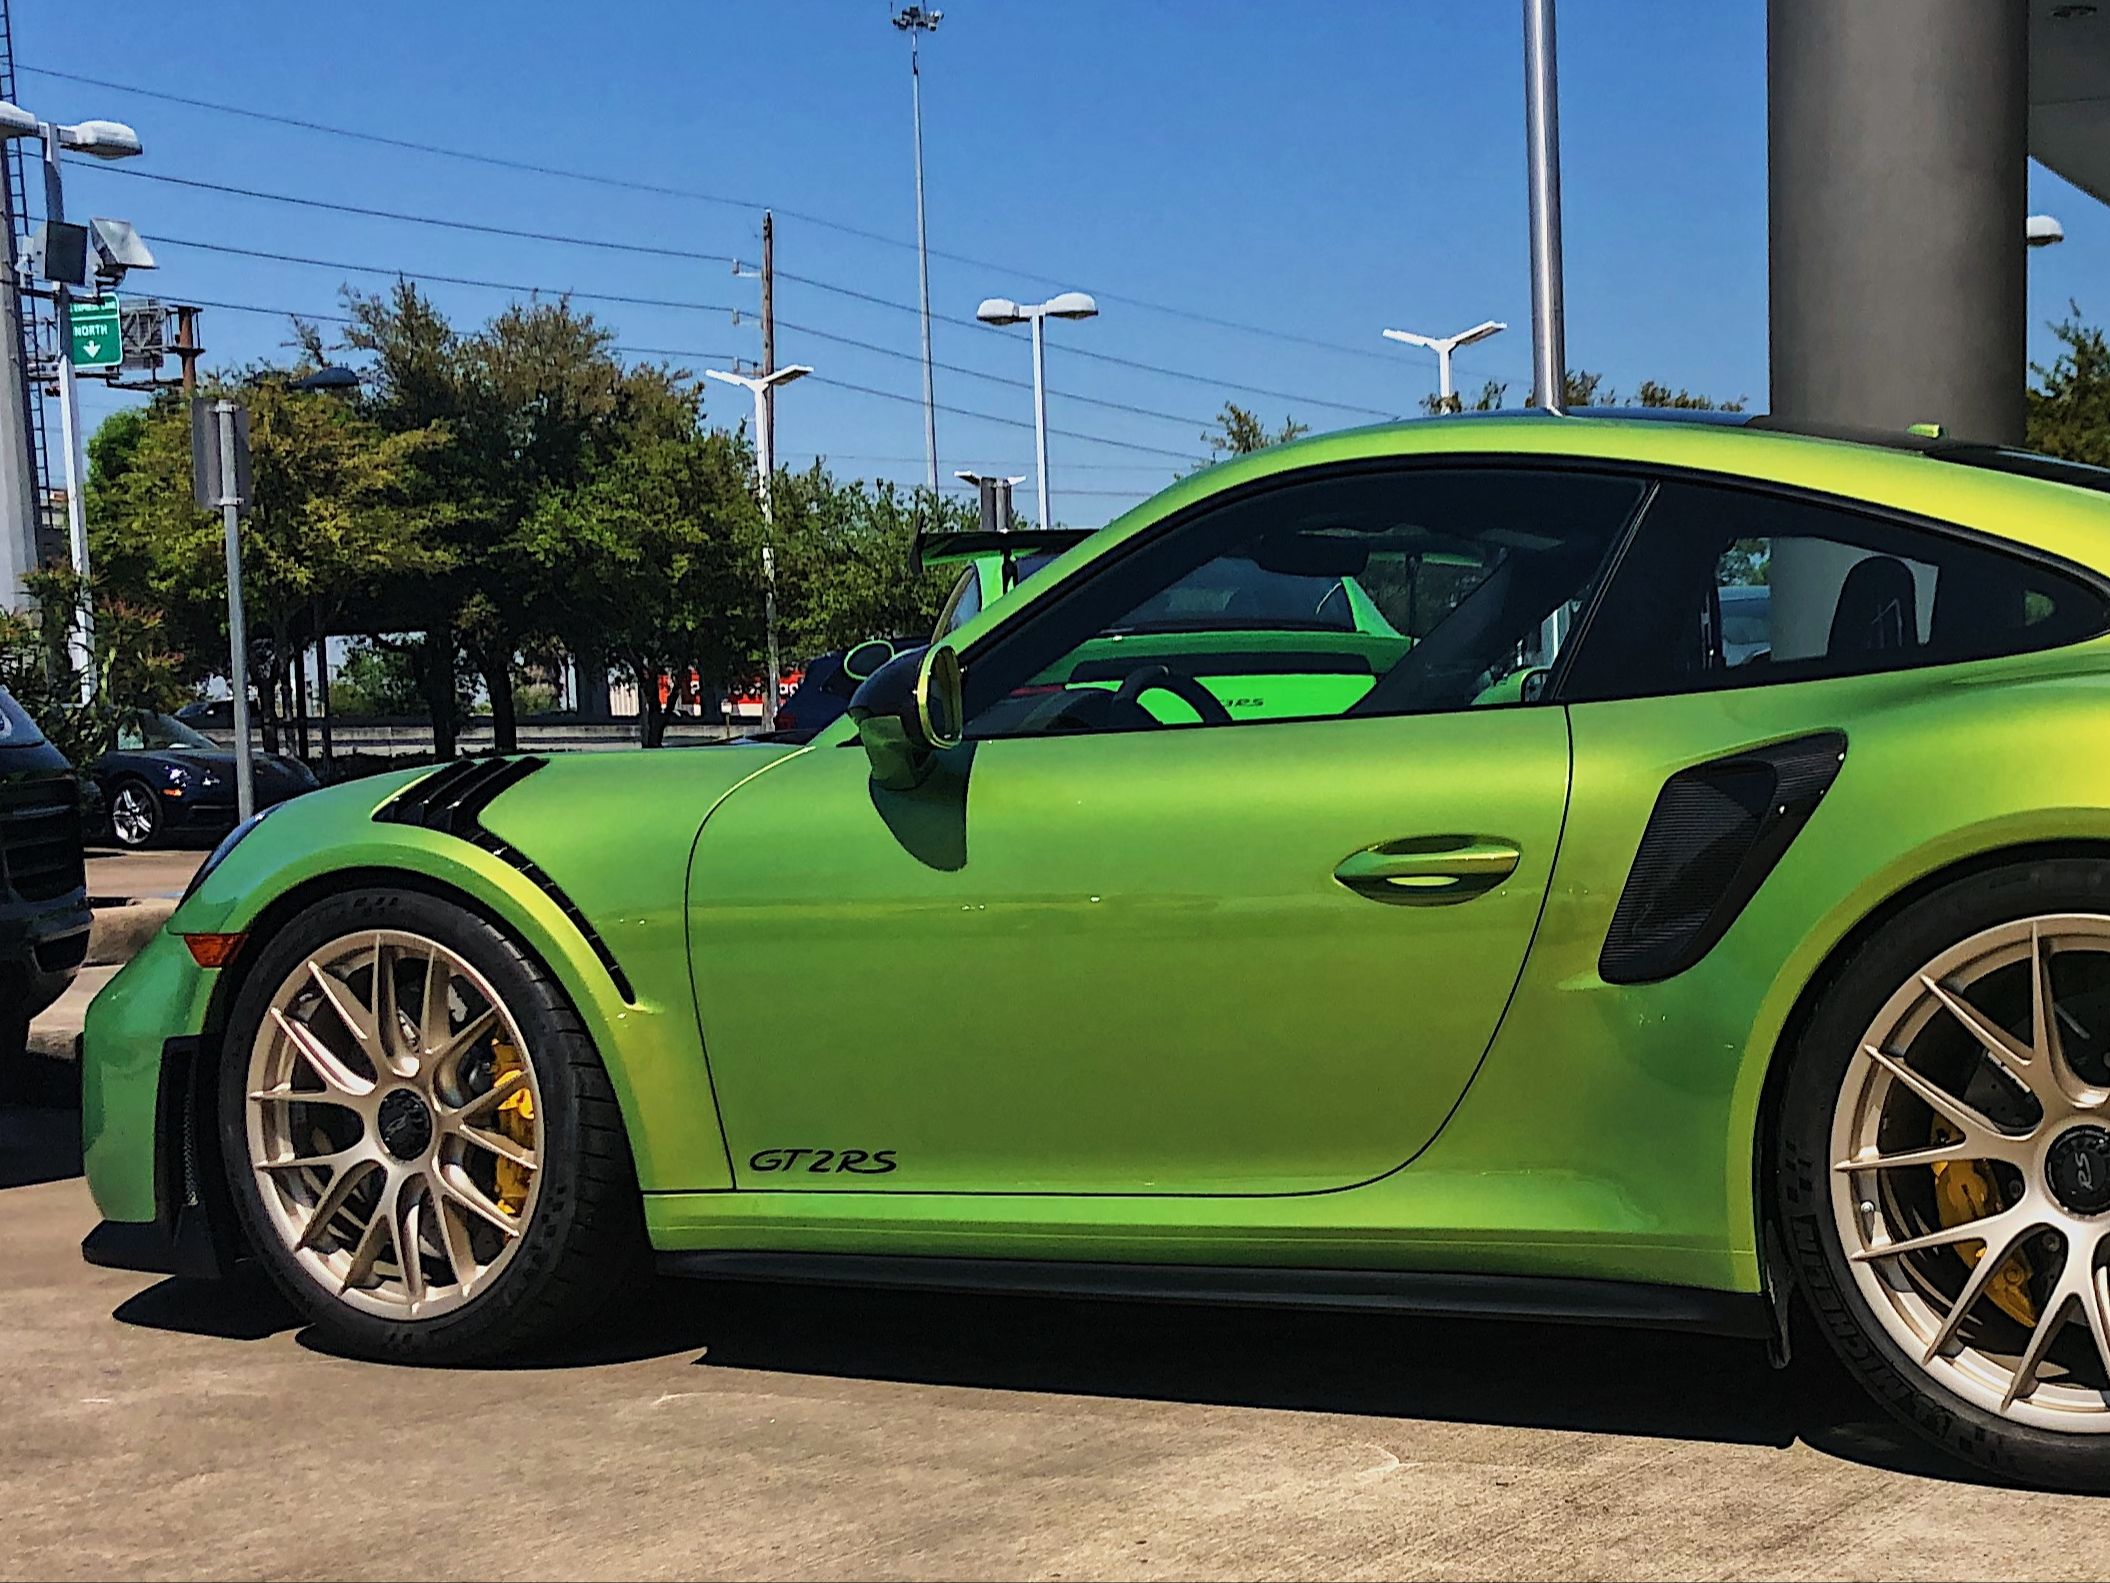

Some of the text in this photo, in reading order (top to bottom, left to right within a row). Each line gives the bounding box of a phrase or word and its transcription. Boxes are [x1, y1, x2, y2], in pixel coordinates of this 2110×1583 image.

[73, 323, 108, 337] NORTH
[750, 1149, 897, 1174] GT2RS
[2074, 1152, 2094, 1191] RS
